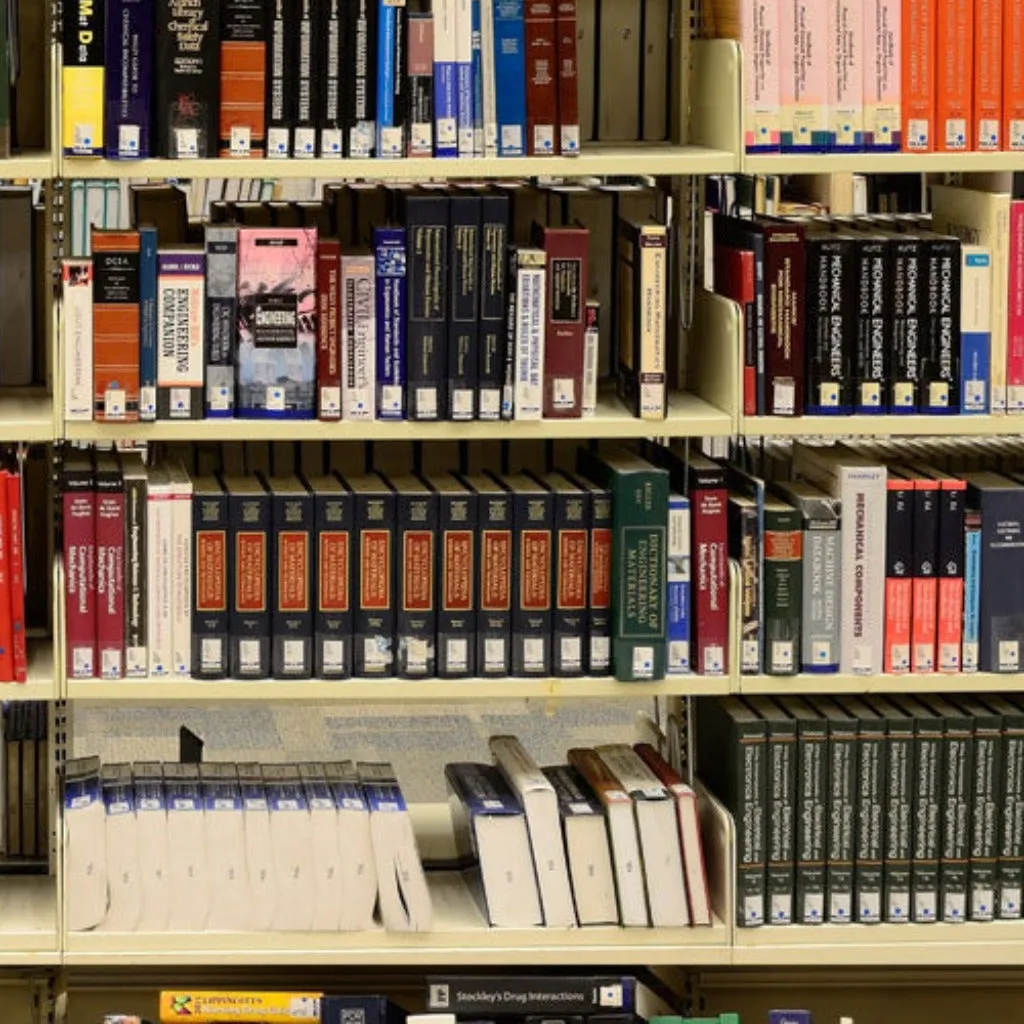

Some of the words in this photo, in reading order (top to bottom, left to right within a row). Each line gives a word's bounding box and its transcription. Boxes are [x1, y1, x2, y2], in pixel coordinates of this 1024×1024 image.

[79, 31, 93, 62] Data
[163, 288, 175, 357] COMPANION
[176, 288, 188, 372] ENGINEERING
[855, 493, 865, 561] MECHANICAL
[854, 565, 863, 638] COMPONENTS
[528, 991, 584, 1004] Interactions
